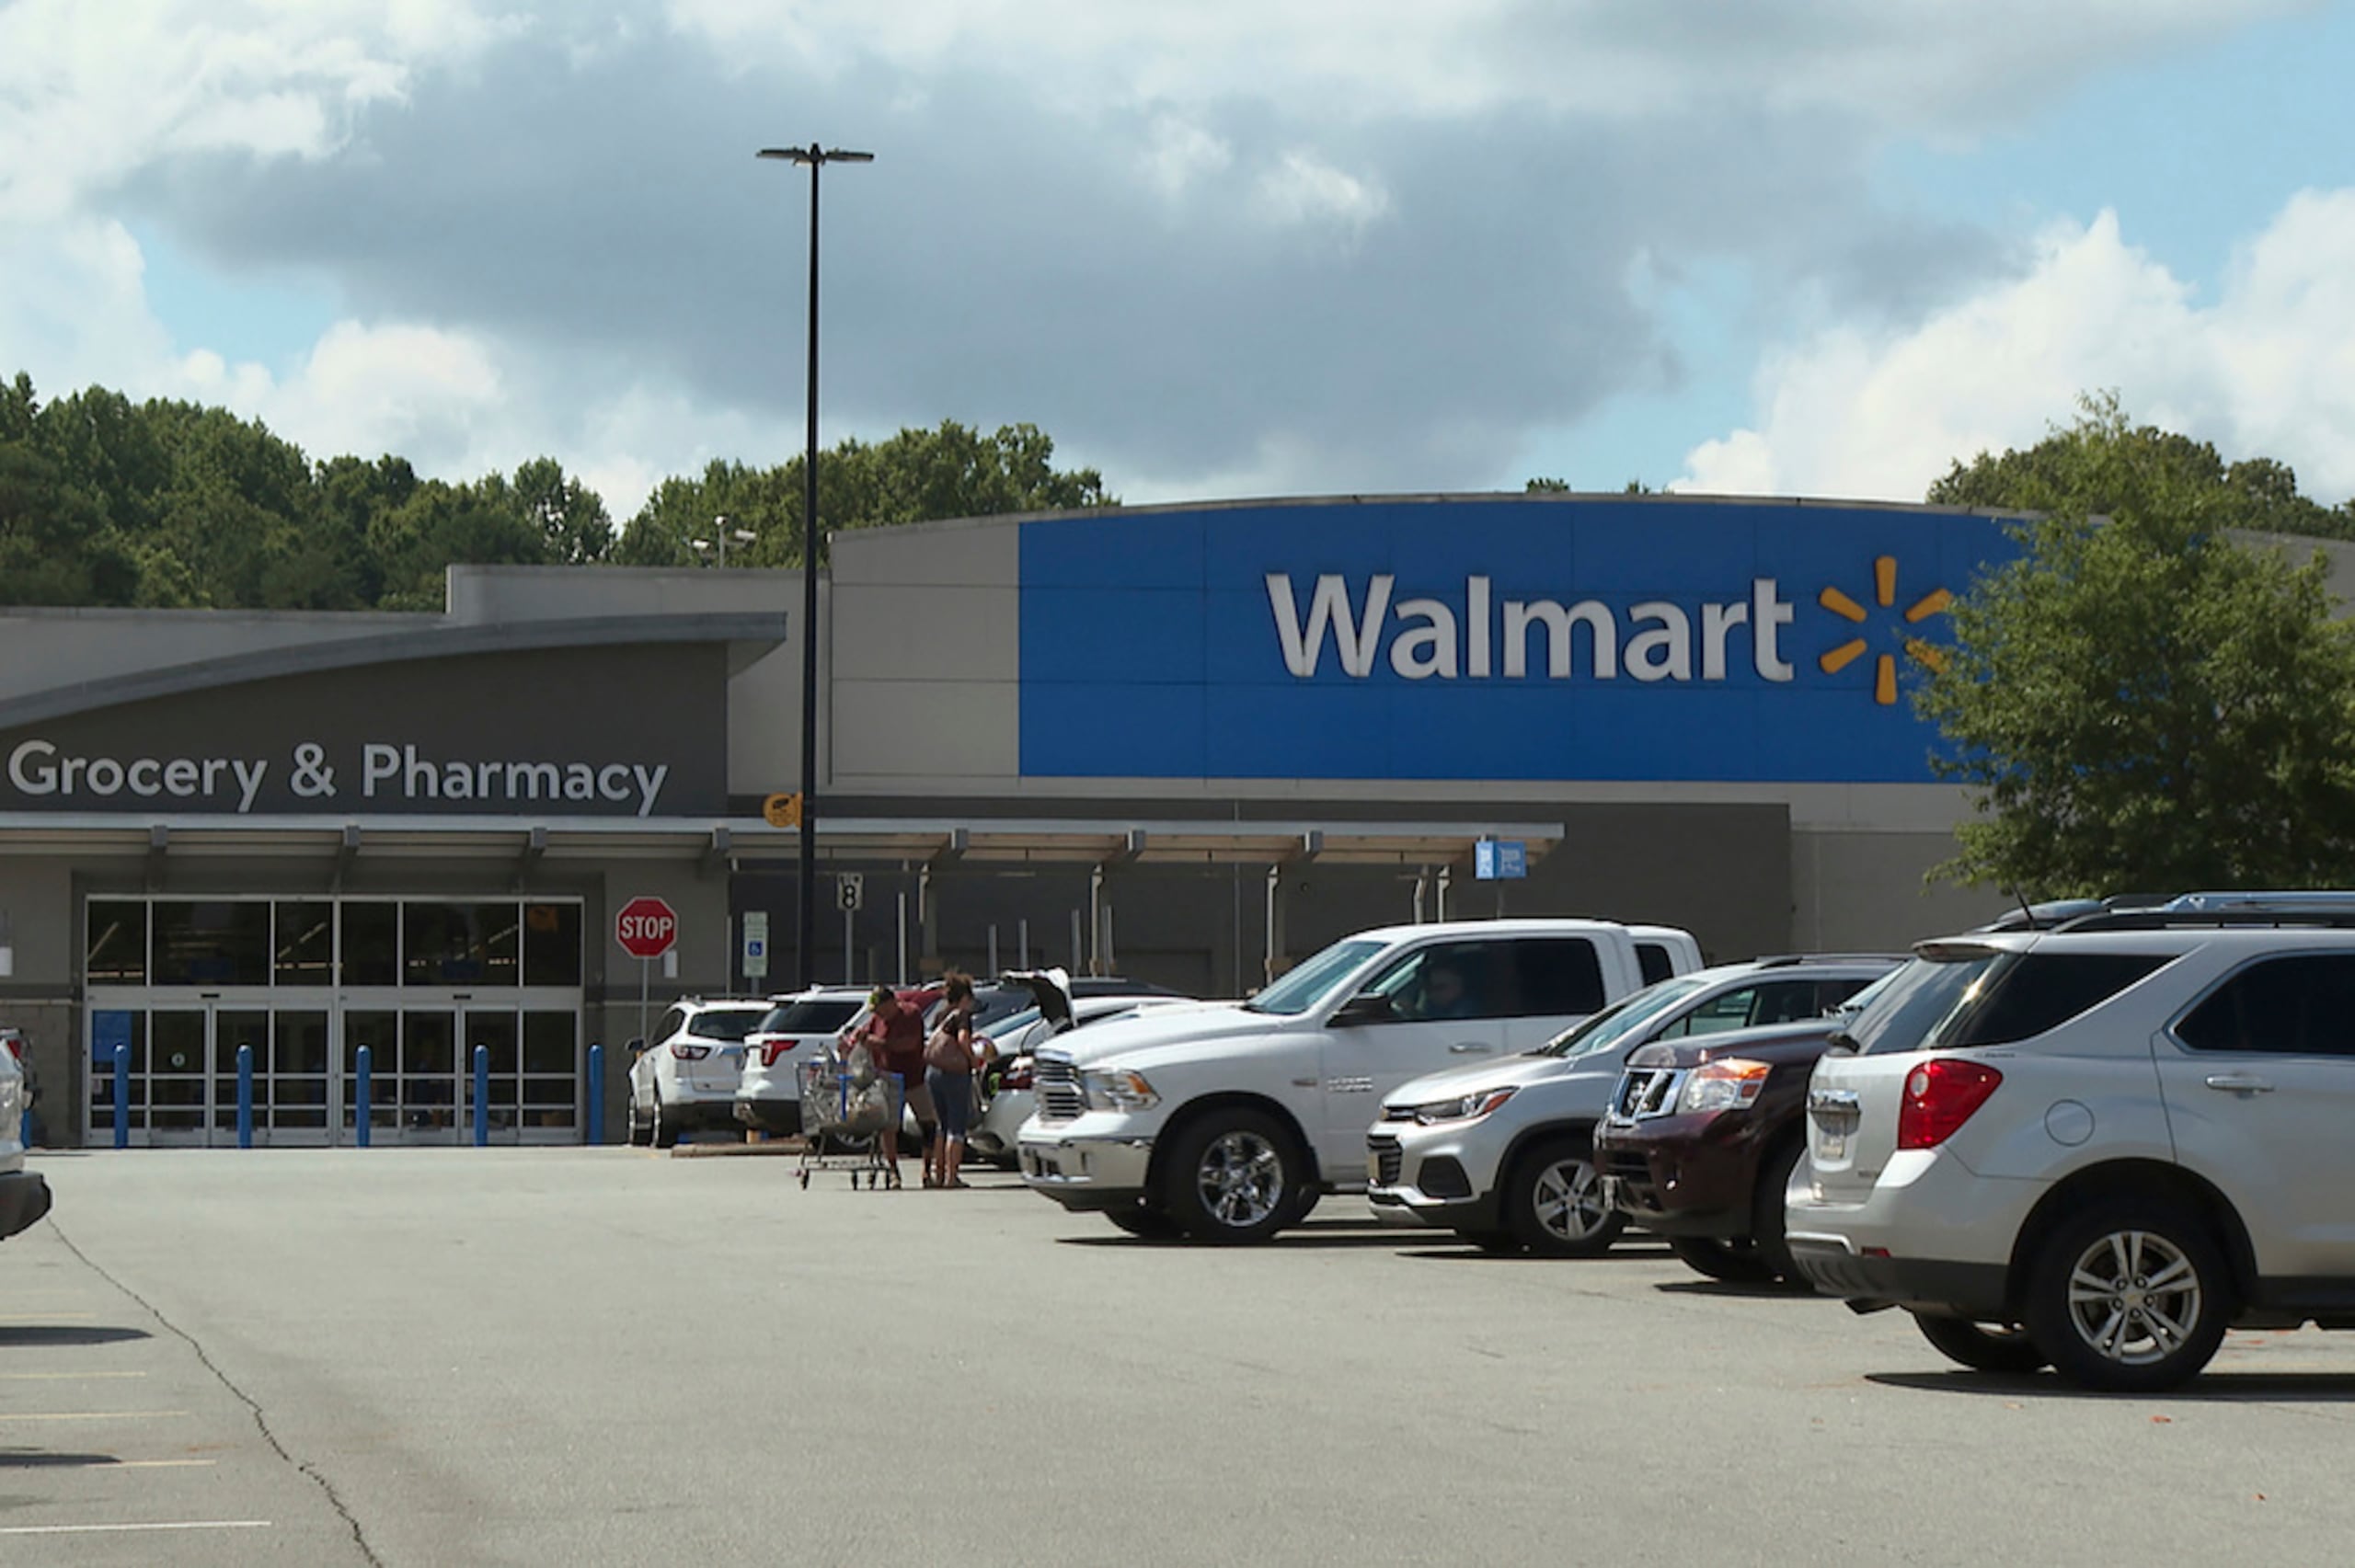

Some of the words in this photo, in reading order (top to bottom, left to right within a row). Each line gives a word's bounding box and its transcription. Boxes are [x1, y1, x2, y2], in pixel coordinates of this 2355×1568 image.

[1265, 573, 1795, 682] Walmart
[8, 739, 268, 813] Grocery
[289, 742, 338, 797] &
[362, 744, 668, 817] Pharmacy
[842, 884, 856, 909] 8
[620, 915, 672, 940] STOP
